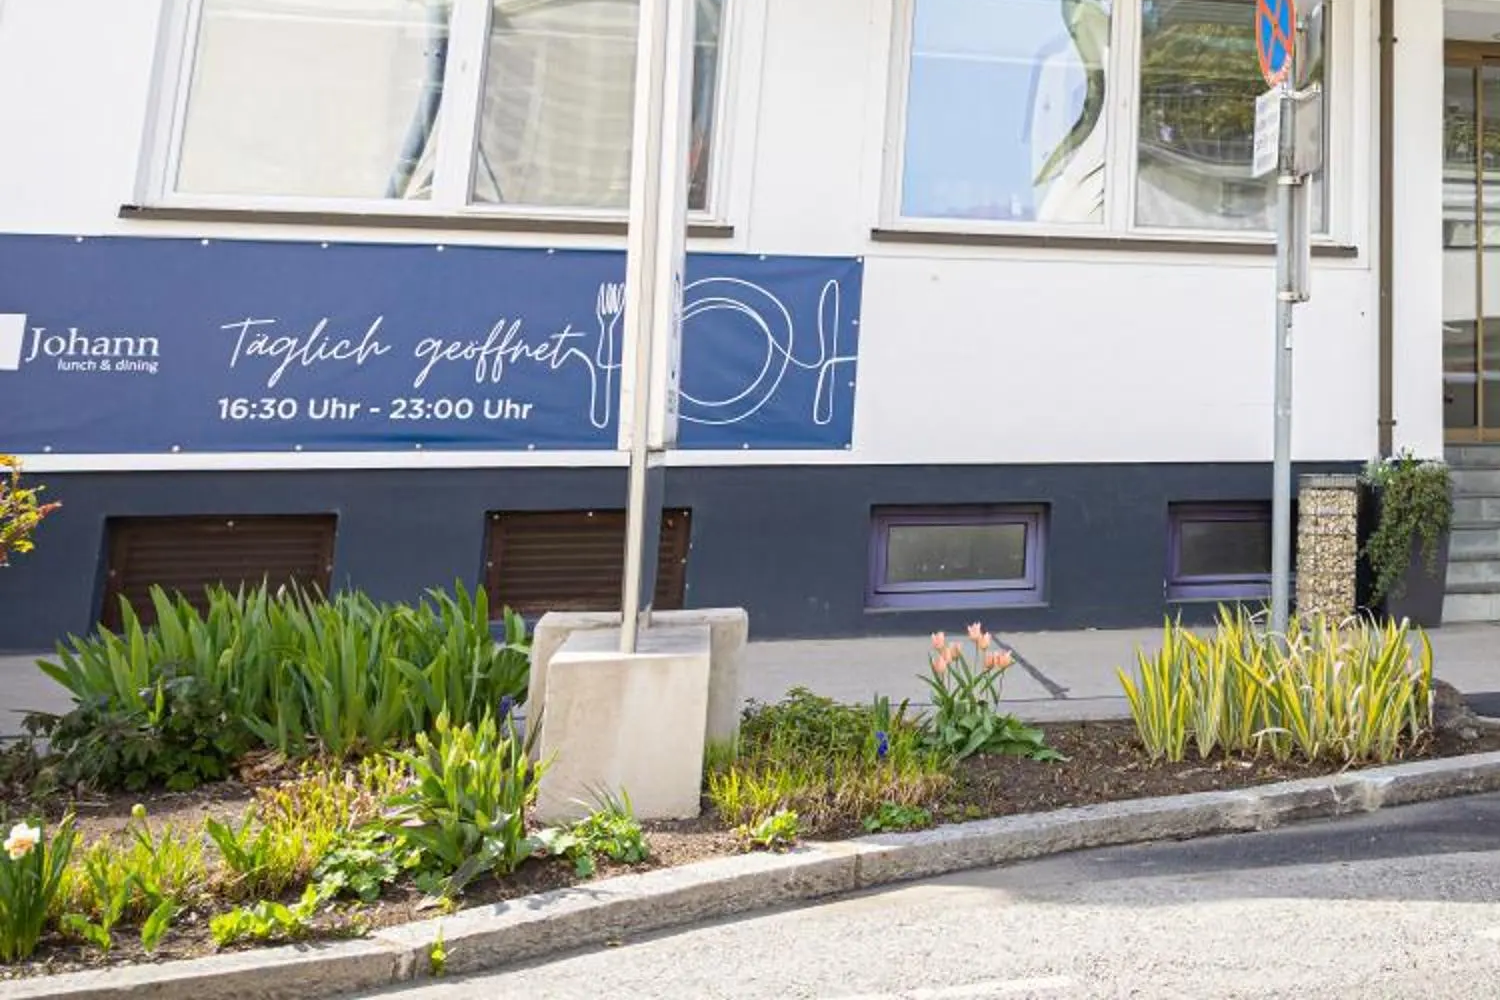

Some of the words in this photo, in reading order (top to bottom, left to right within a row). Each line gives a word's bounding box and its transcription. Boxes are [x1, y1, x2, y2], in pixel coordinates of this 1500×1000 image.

[25, 327, 160, 363] Johann
[220, 315, 392, 388] Täglich
[413, 318, 588, 388] geöffnet
[57, 359, 97, 371] lunch
[99, 360, 112, 371] &
[115, 359, 159, 374] dining
[218, 398, 298, 420] 16:30
[308, 398, 361, 420] Uhr
[389, 398, 474, 420] 23:00
[483, 398, 533, 420] Uhr
